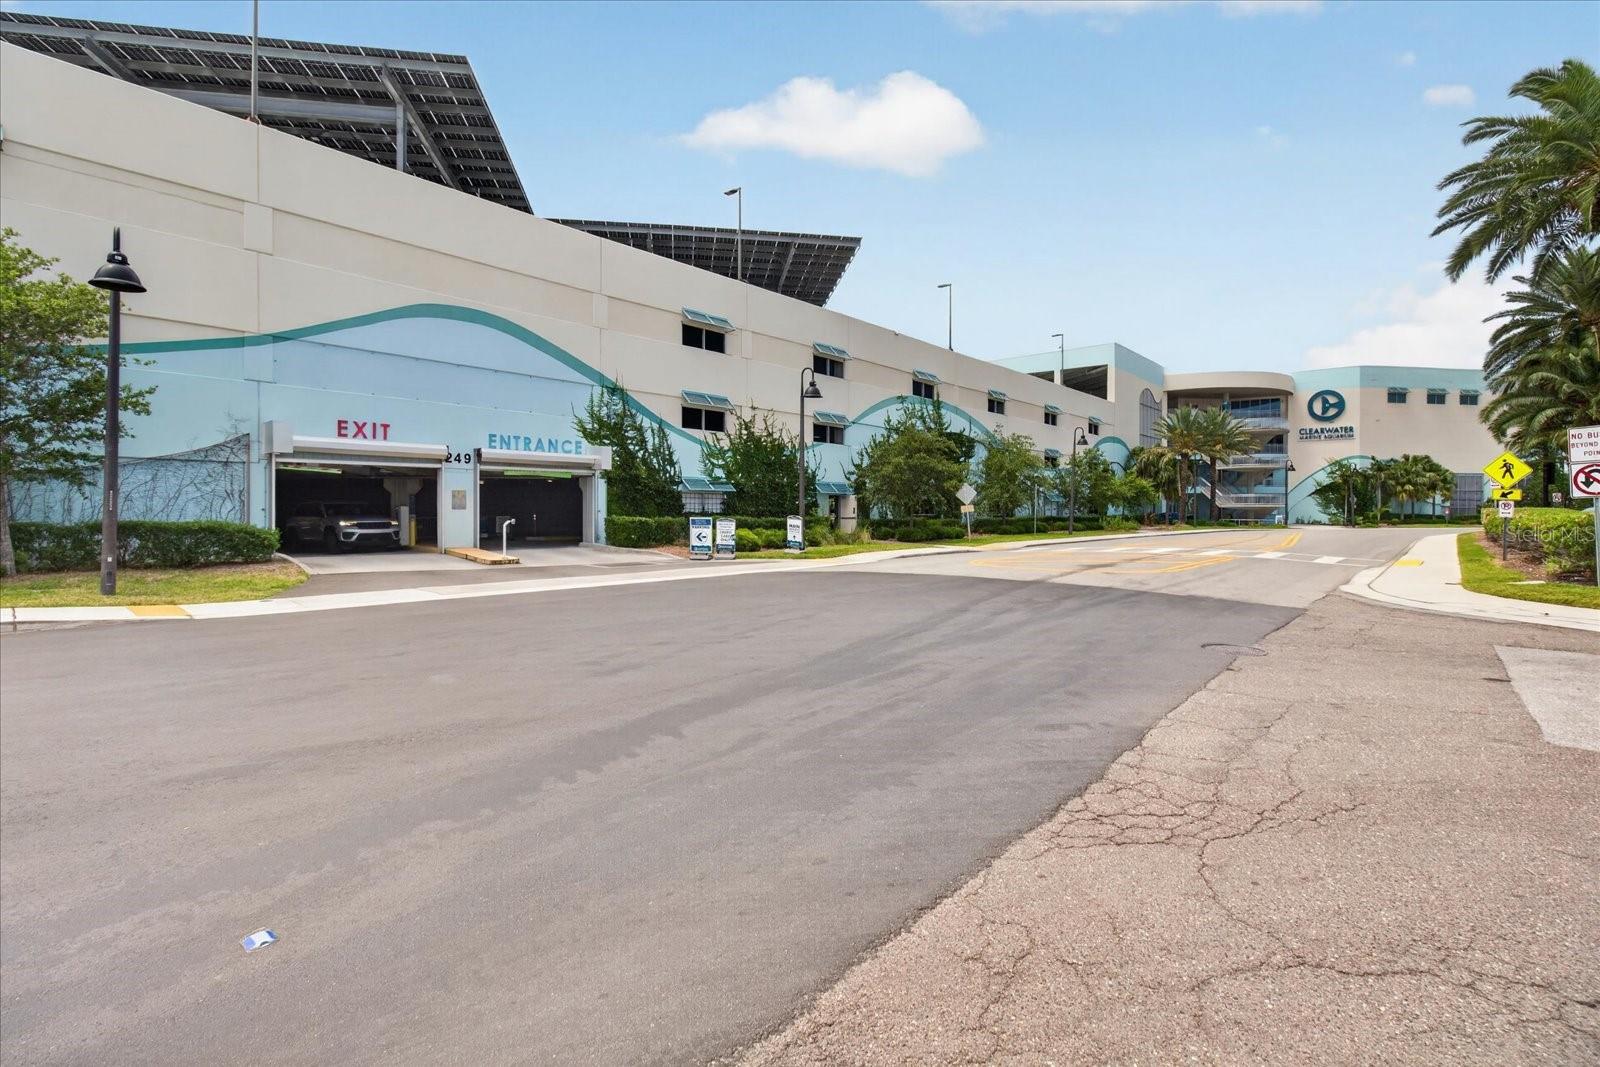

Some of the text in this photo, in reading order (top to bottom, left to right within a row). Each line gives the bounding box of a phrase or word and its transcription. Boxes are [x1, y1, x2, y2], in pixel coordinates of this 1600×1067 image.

[337, 419, 391, 440] EXIT
[1299, 426, 1354, 435] CLEARWATER
[1571, 432, 1583, 440] NO
[488, 433, 583, 455] ENTRANCE
[445, 453, 472, 464] 249
